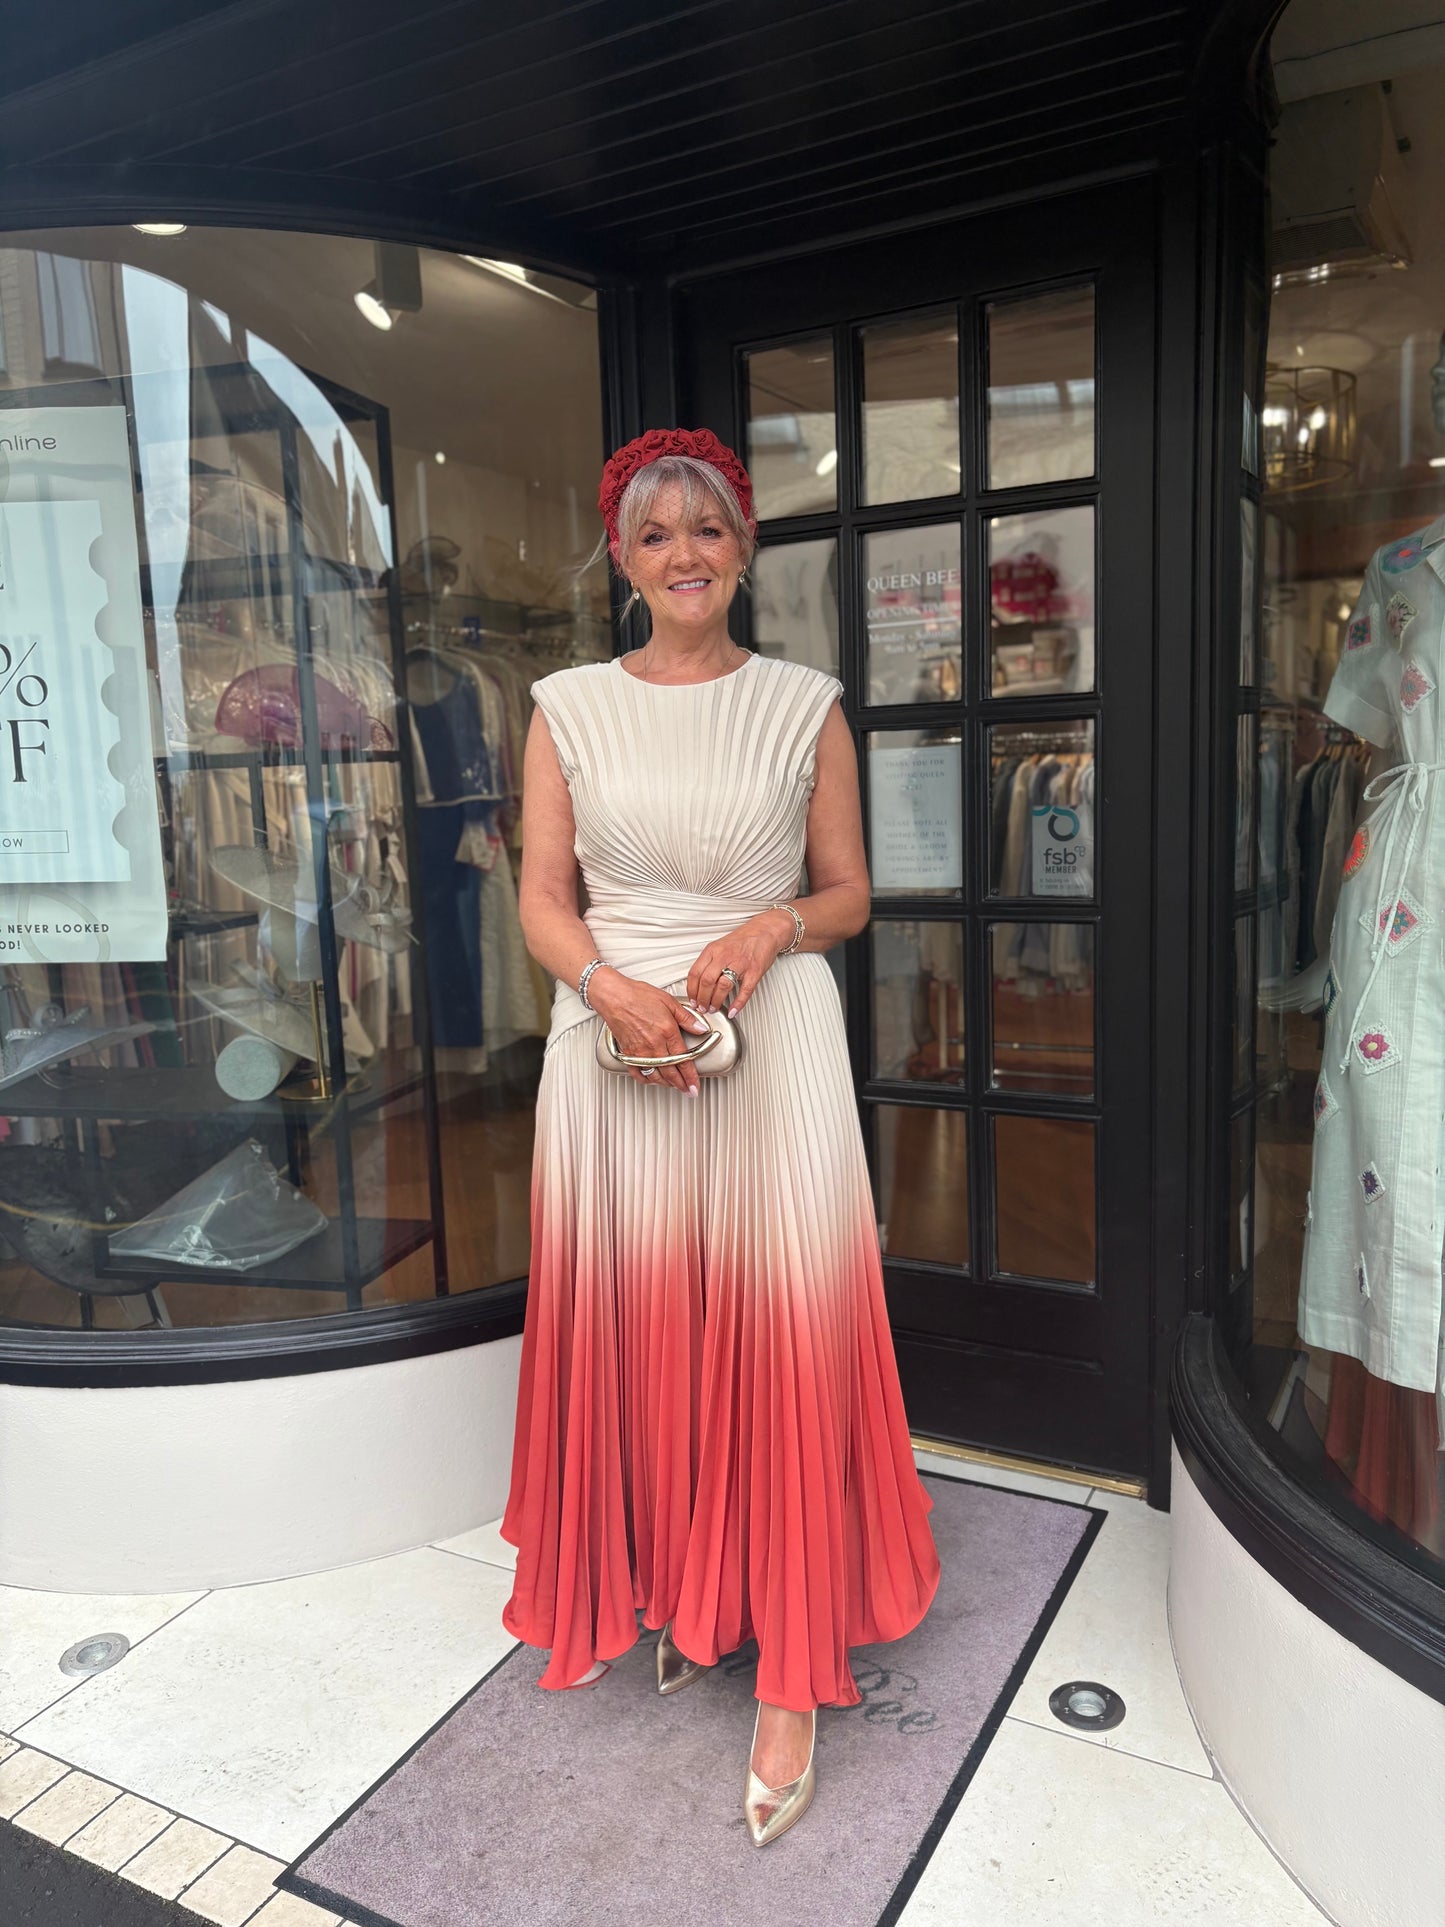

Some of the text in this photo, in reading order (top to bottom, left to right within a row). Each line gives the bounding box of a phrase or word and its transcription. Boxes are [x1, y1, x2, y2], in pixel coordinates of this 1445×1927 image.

[867, 568, 958, 594] QUEEN BEE
[1043, 847, 1077, 865] fsb
[1045, 865, 1077, 874] MEMBER
[7, 923, 110, 934] NEVER LOOKED
